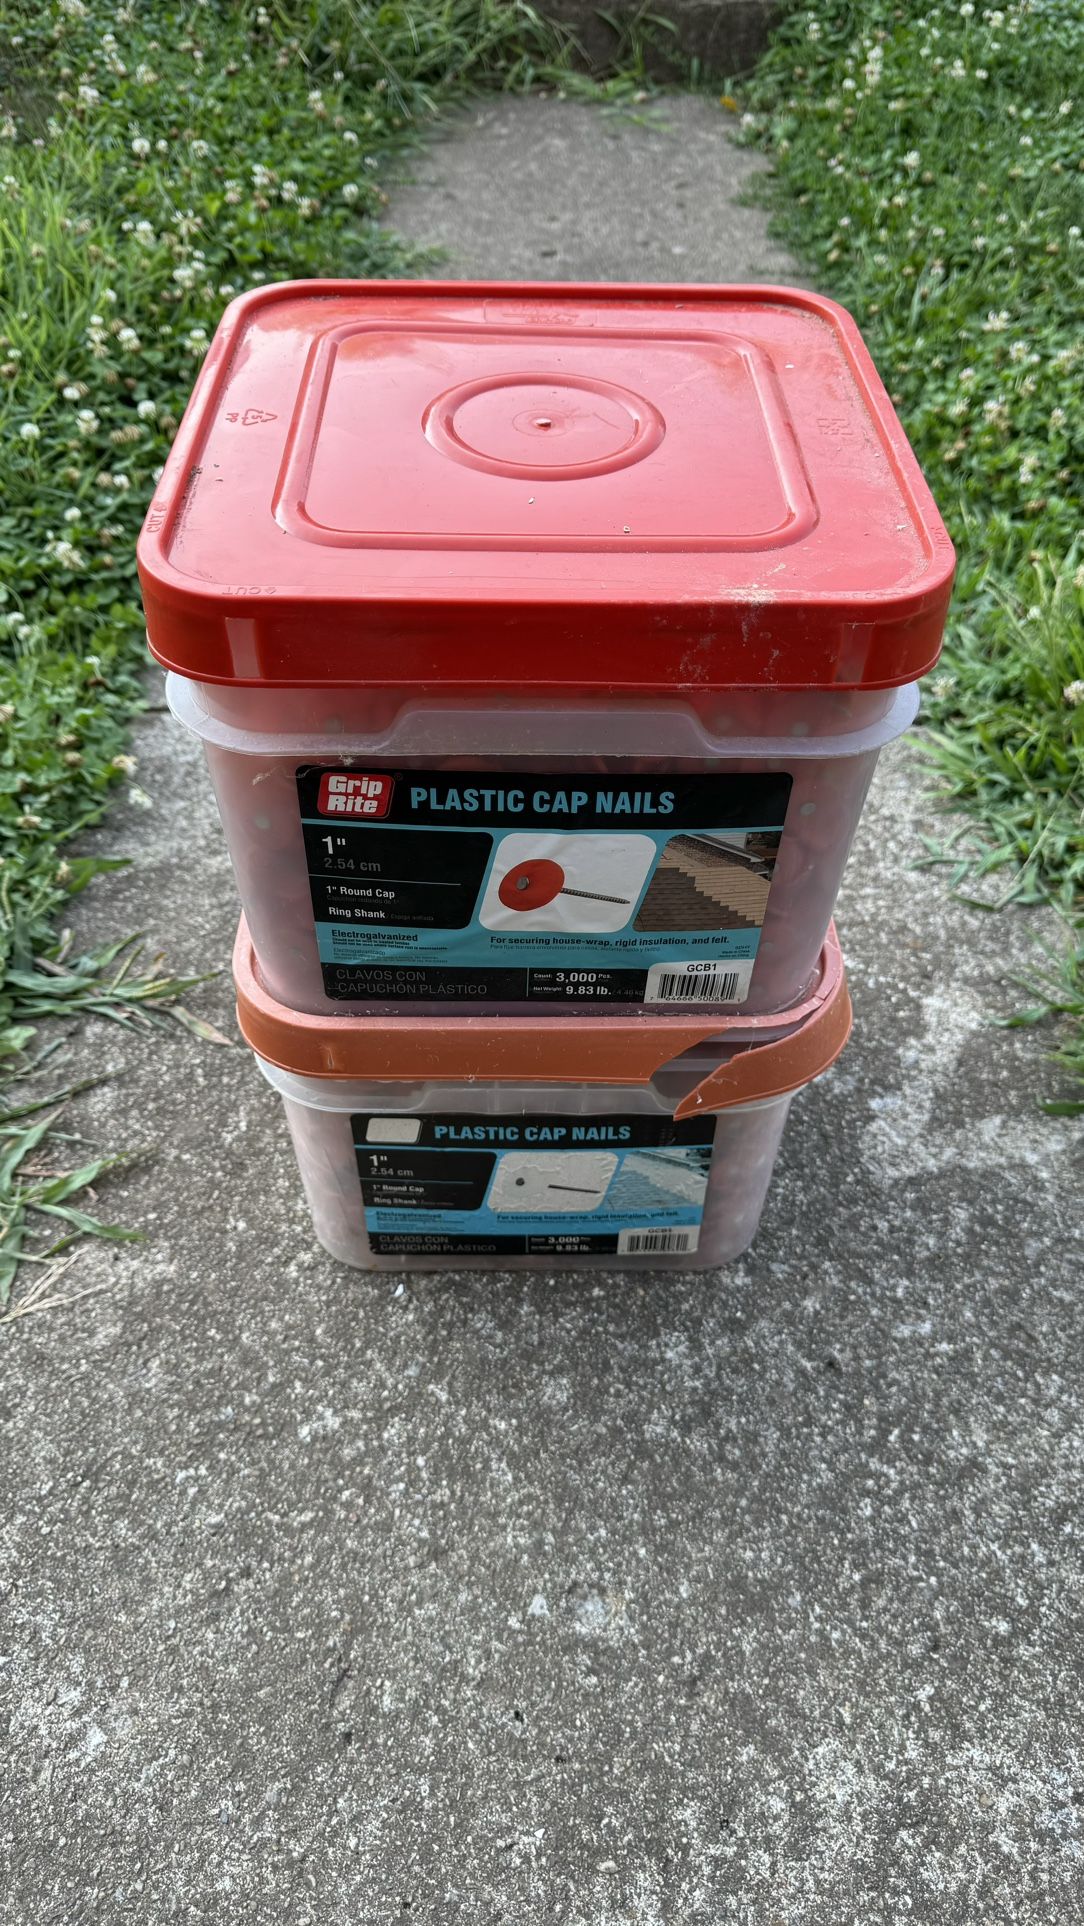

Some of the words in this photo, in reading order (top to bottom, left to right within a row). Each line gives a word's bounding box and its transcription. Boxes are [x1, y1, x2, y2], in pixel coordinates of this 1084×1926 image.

[328, 775, 383, 797] Grip
[327, 795, 378, 813] Rite
[411, 787, 525, 813] PLASTIC
[533, 791, 588, 814] CAP
[596, 791, 675, 814] NAILS
[322, 836, 346, 855] 1"
[324, 858, 355, 870] 2.54
[360, 861, 381, 872] cm
[326, 886, 338, 894] 1"
[340, 887, 373, 897] Round
[376, 888, 396, 900] Cap
[328, 906, 352, 918] Ring
[354, 908, 386, 919] Shank
[331, 929, 418, 942] Electrogalvanized
[490, 936, 506, 944] For
[508, 936, 550, 945] securing
[552, 937, 612, 947] house-wrap,
[615, 938, 637, 947] rigid
[639, 937, 689, 946] insulation,
[691, 936, 710, 944] and
[712, 936, 730, 944] felt.
[687, 963, 717, 973] GCB1
[336, 969, 393, 980] CLAVOS
[396, 971, 426, 981] CON
[556, 972, 597, 983] 3,000
[338, 981, 416, 994] CAPUCHÓN
[420, 982, 488, 995] PLÁSTICO
[566, 986, 594, 995] 9.83
[596, 986, 612, 995] lb.
[434, 1126, 520, 1140] PLASTIC
[525, 1127, 567, 1141] CAP
[572, 1126, 631, 1140] NAILS
[369, 1155, 388, 1167] 1"
[370, 1167, 394, 1176] 2.54
[397, 1169, 414, 1177] cm
[409, 1185, 424, 1193] Cap
[379, 1235, 423, 1243] CLAVOS
[424, 1236, 449, 1244] CON
